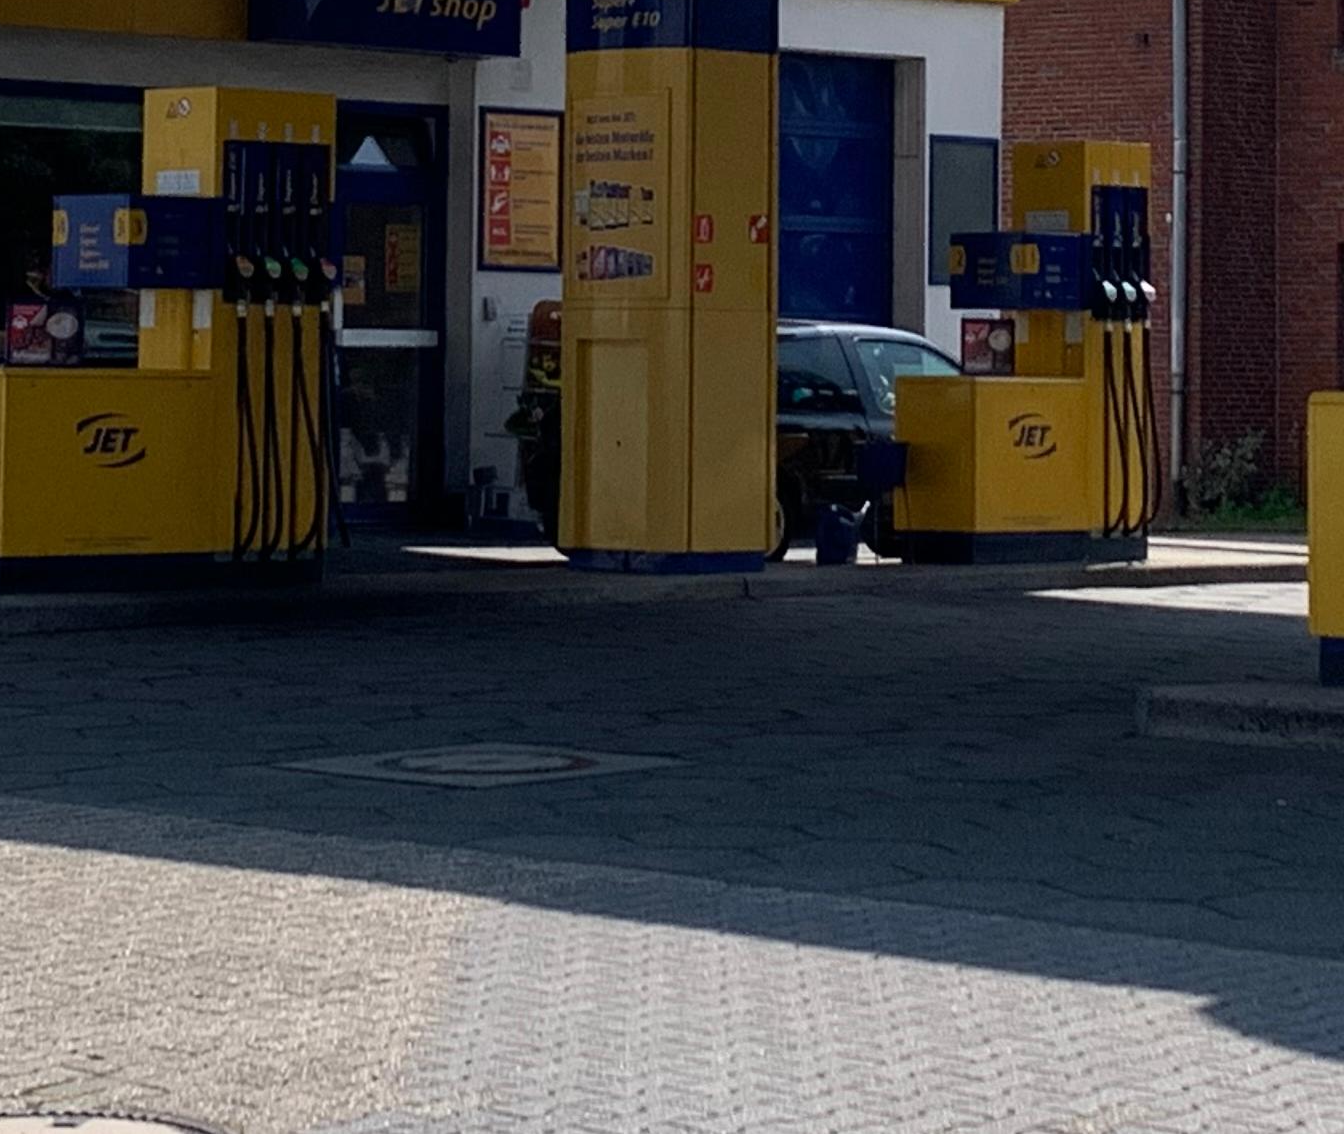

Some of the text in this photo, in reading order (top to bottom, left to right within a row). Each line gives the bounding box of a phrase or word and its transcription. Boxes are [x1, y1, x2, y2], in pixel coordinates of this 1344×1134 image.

[591, 10, 661, 33] Super E10
[83, 427, 139, 455] JET
[1013, 424, 1053, 448] JET
